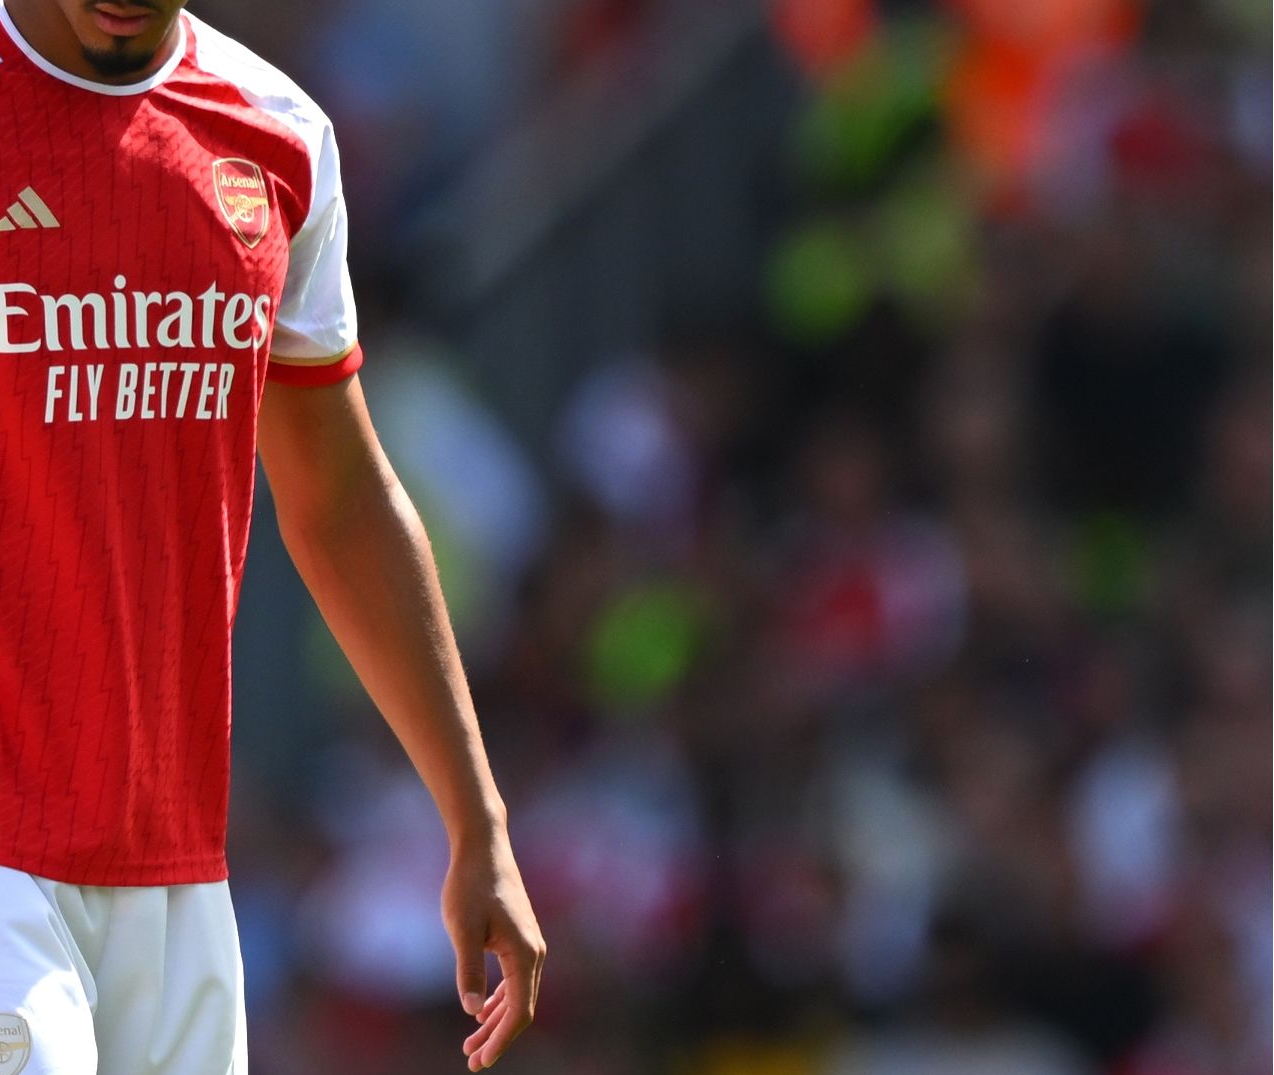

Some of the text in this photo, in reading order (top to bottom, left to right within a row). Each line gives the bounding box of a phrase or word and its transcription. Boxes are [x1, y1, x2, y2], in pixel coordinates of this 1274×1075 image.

[220, 173, 259, 189] Arsenal
[44, 362, 235, 424] FLY BETTER
